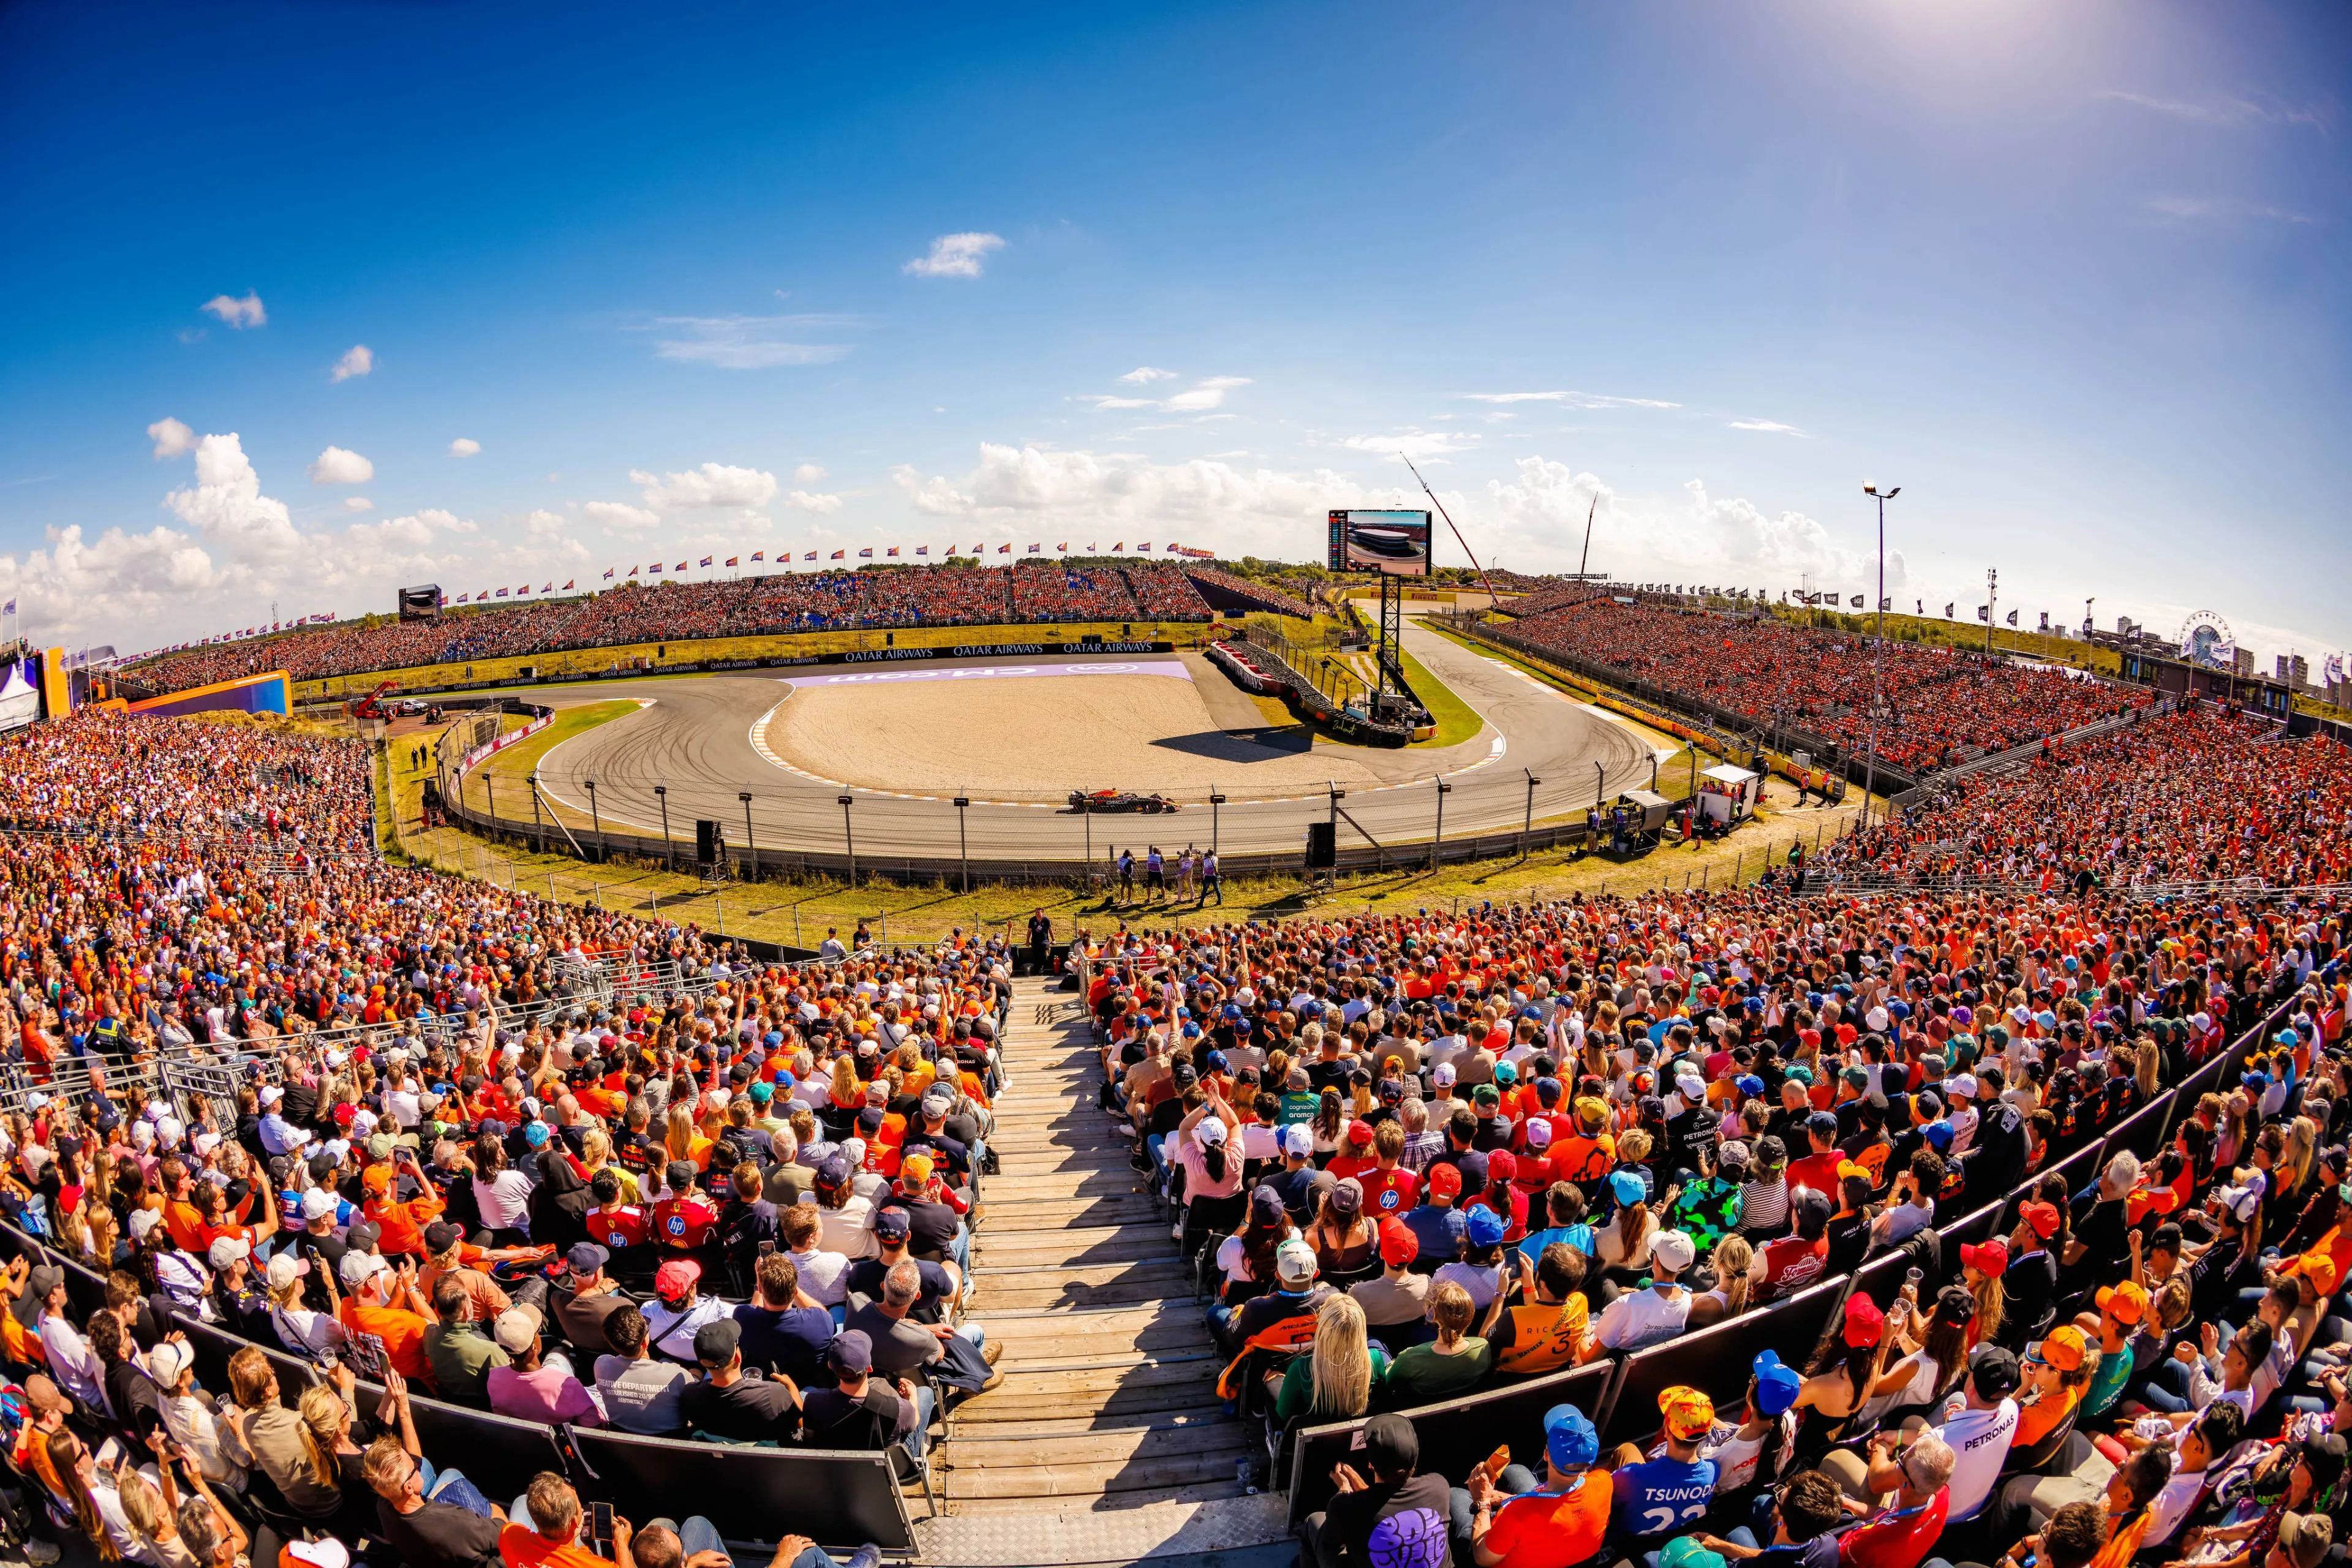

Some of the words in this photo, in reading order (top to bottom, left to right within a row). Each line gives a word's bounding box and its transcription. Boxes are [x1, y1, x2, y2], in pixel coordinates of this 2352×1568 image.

[846, 650, 883, 663] QATAR
[886, 648, 933, 659] AIRWAYS
[954, 646, 992, 657] QATAR
[995, 644, 1042, 654] AIRWAYS
[1064, 643, 1101, 654] QATAR
[1105, 643, 1152, 652] AIRWAYS
[499, 736, 511, 747] QATAR
[471, 751, 481, 764] QATAR
[1954, 1121, 1978, 1137] PETRONA
[621, 1151, 633, 1159] Red
[634, 1153, 646, 1163] Bull
[1382, 1190, 1396, 1208] hp
[670, 1216, 683, 1235] hp
[611, 1232, 624, 1246] hp
[1551, 1330, 1570, 1354] 3
[597, 1377, 622, 1389] CREATIVE
[622, 1381, 669, 1393] DEPARTMENT
[606, 1389, 638, 1398] ESTABLISHED
[1964, 1414, 2015, 1452] PETRONAS
[1645, 1480, 1717, 1502] TSUNODA
